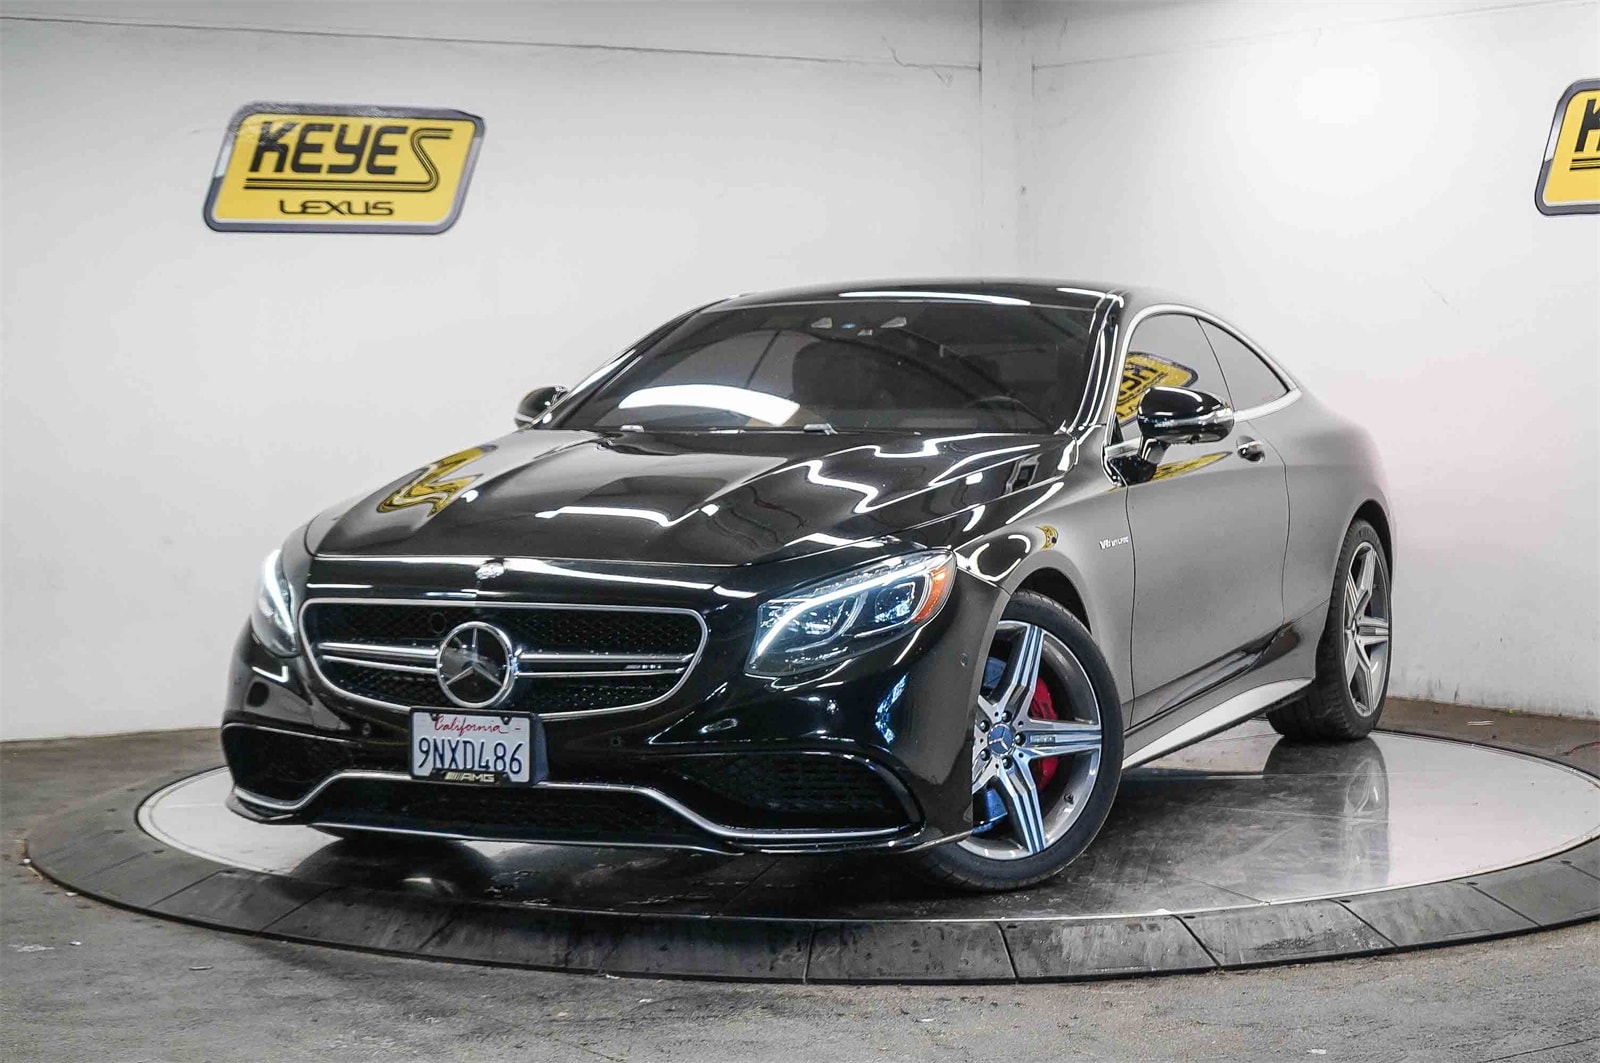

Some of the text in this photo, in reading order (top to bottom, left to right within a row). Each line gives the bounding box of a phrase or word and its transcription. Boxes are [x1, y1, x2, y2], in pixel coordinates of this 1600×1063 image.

[244, 121, 453, 192] KEYES
[279, 199, 395, 216] LEXUS
[434, 715, 508, 737] California
[418, 737, 524, 775] 9NXD486
